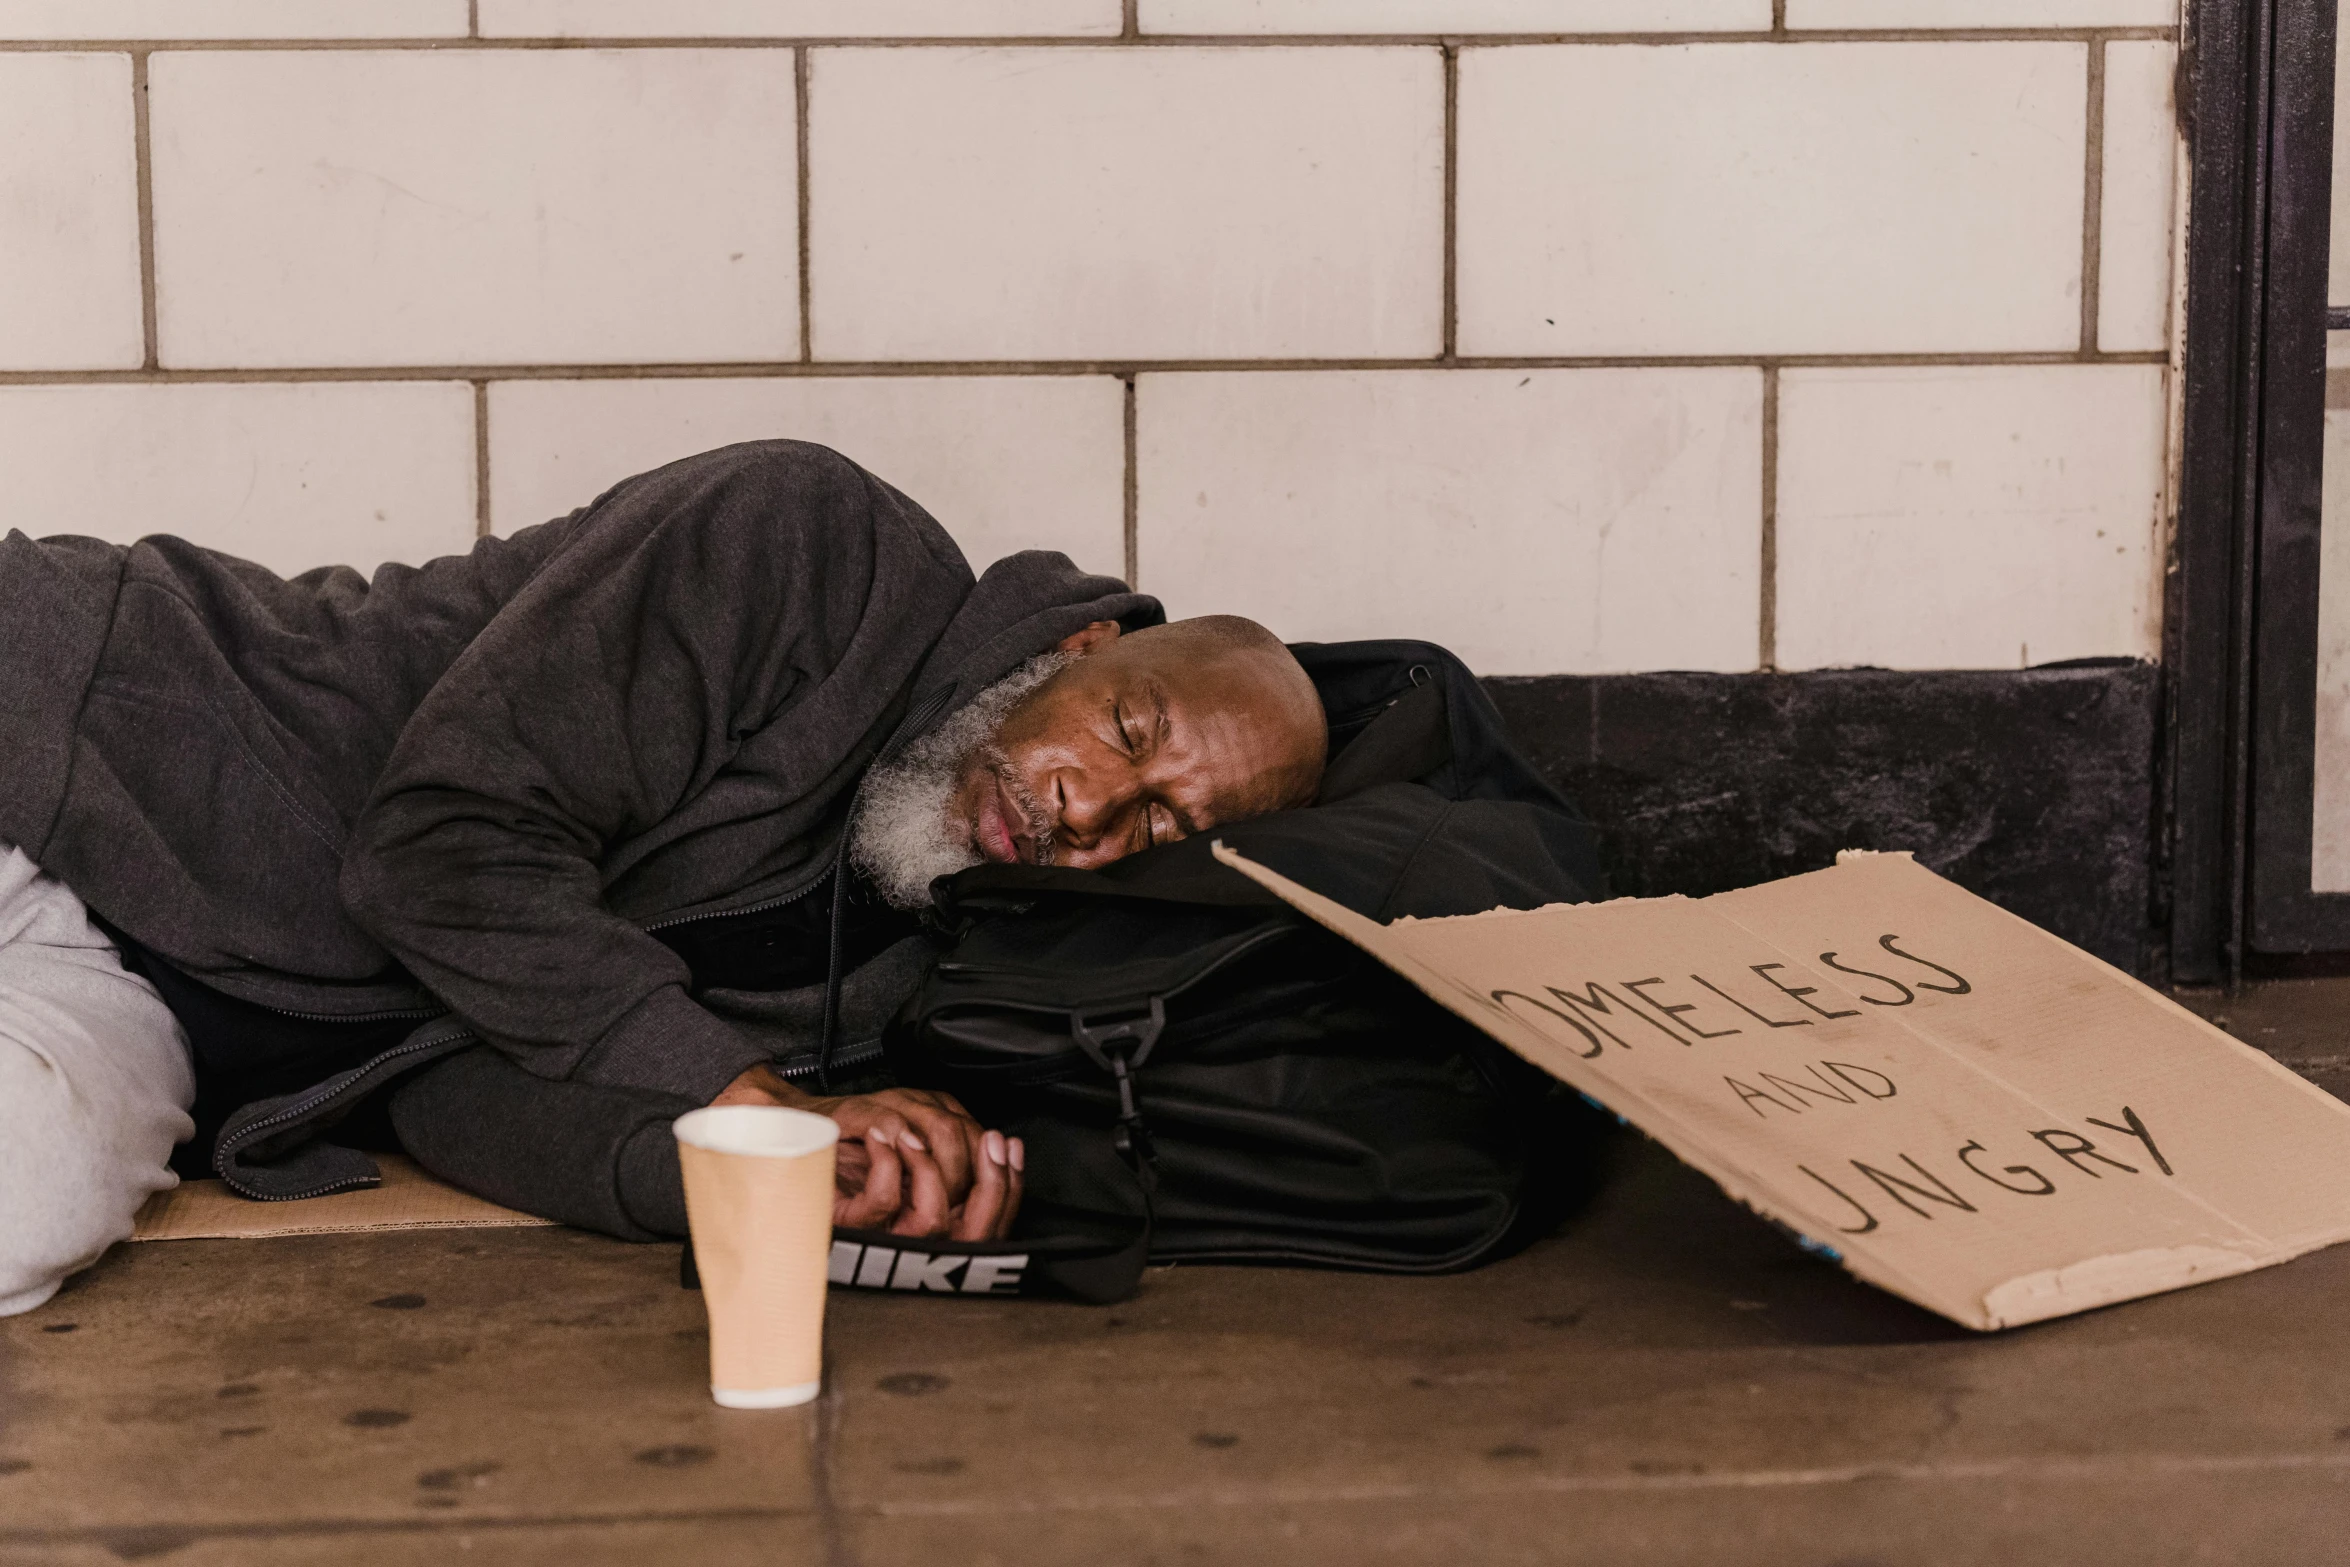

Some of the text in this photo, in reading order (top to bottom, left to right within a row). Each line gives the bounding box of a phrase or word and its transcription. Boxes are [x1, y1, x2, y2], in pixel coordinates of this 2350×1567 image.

[1490, 933, 1972, 1060] OMELESS
[1722, 1060, 1898, 1119] AND
[1796, 1105, 2175, 1235] UNGRY
